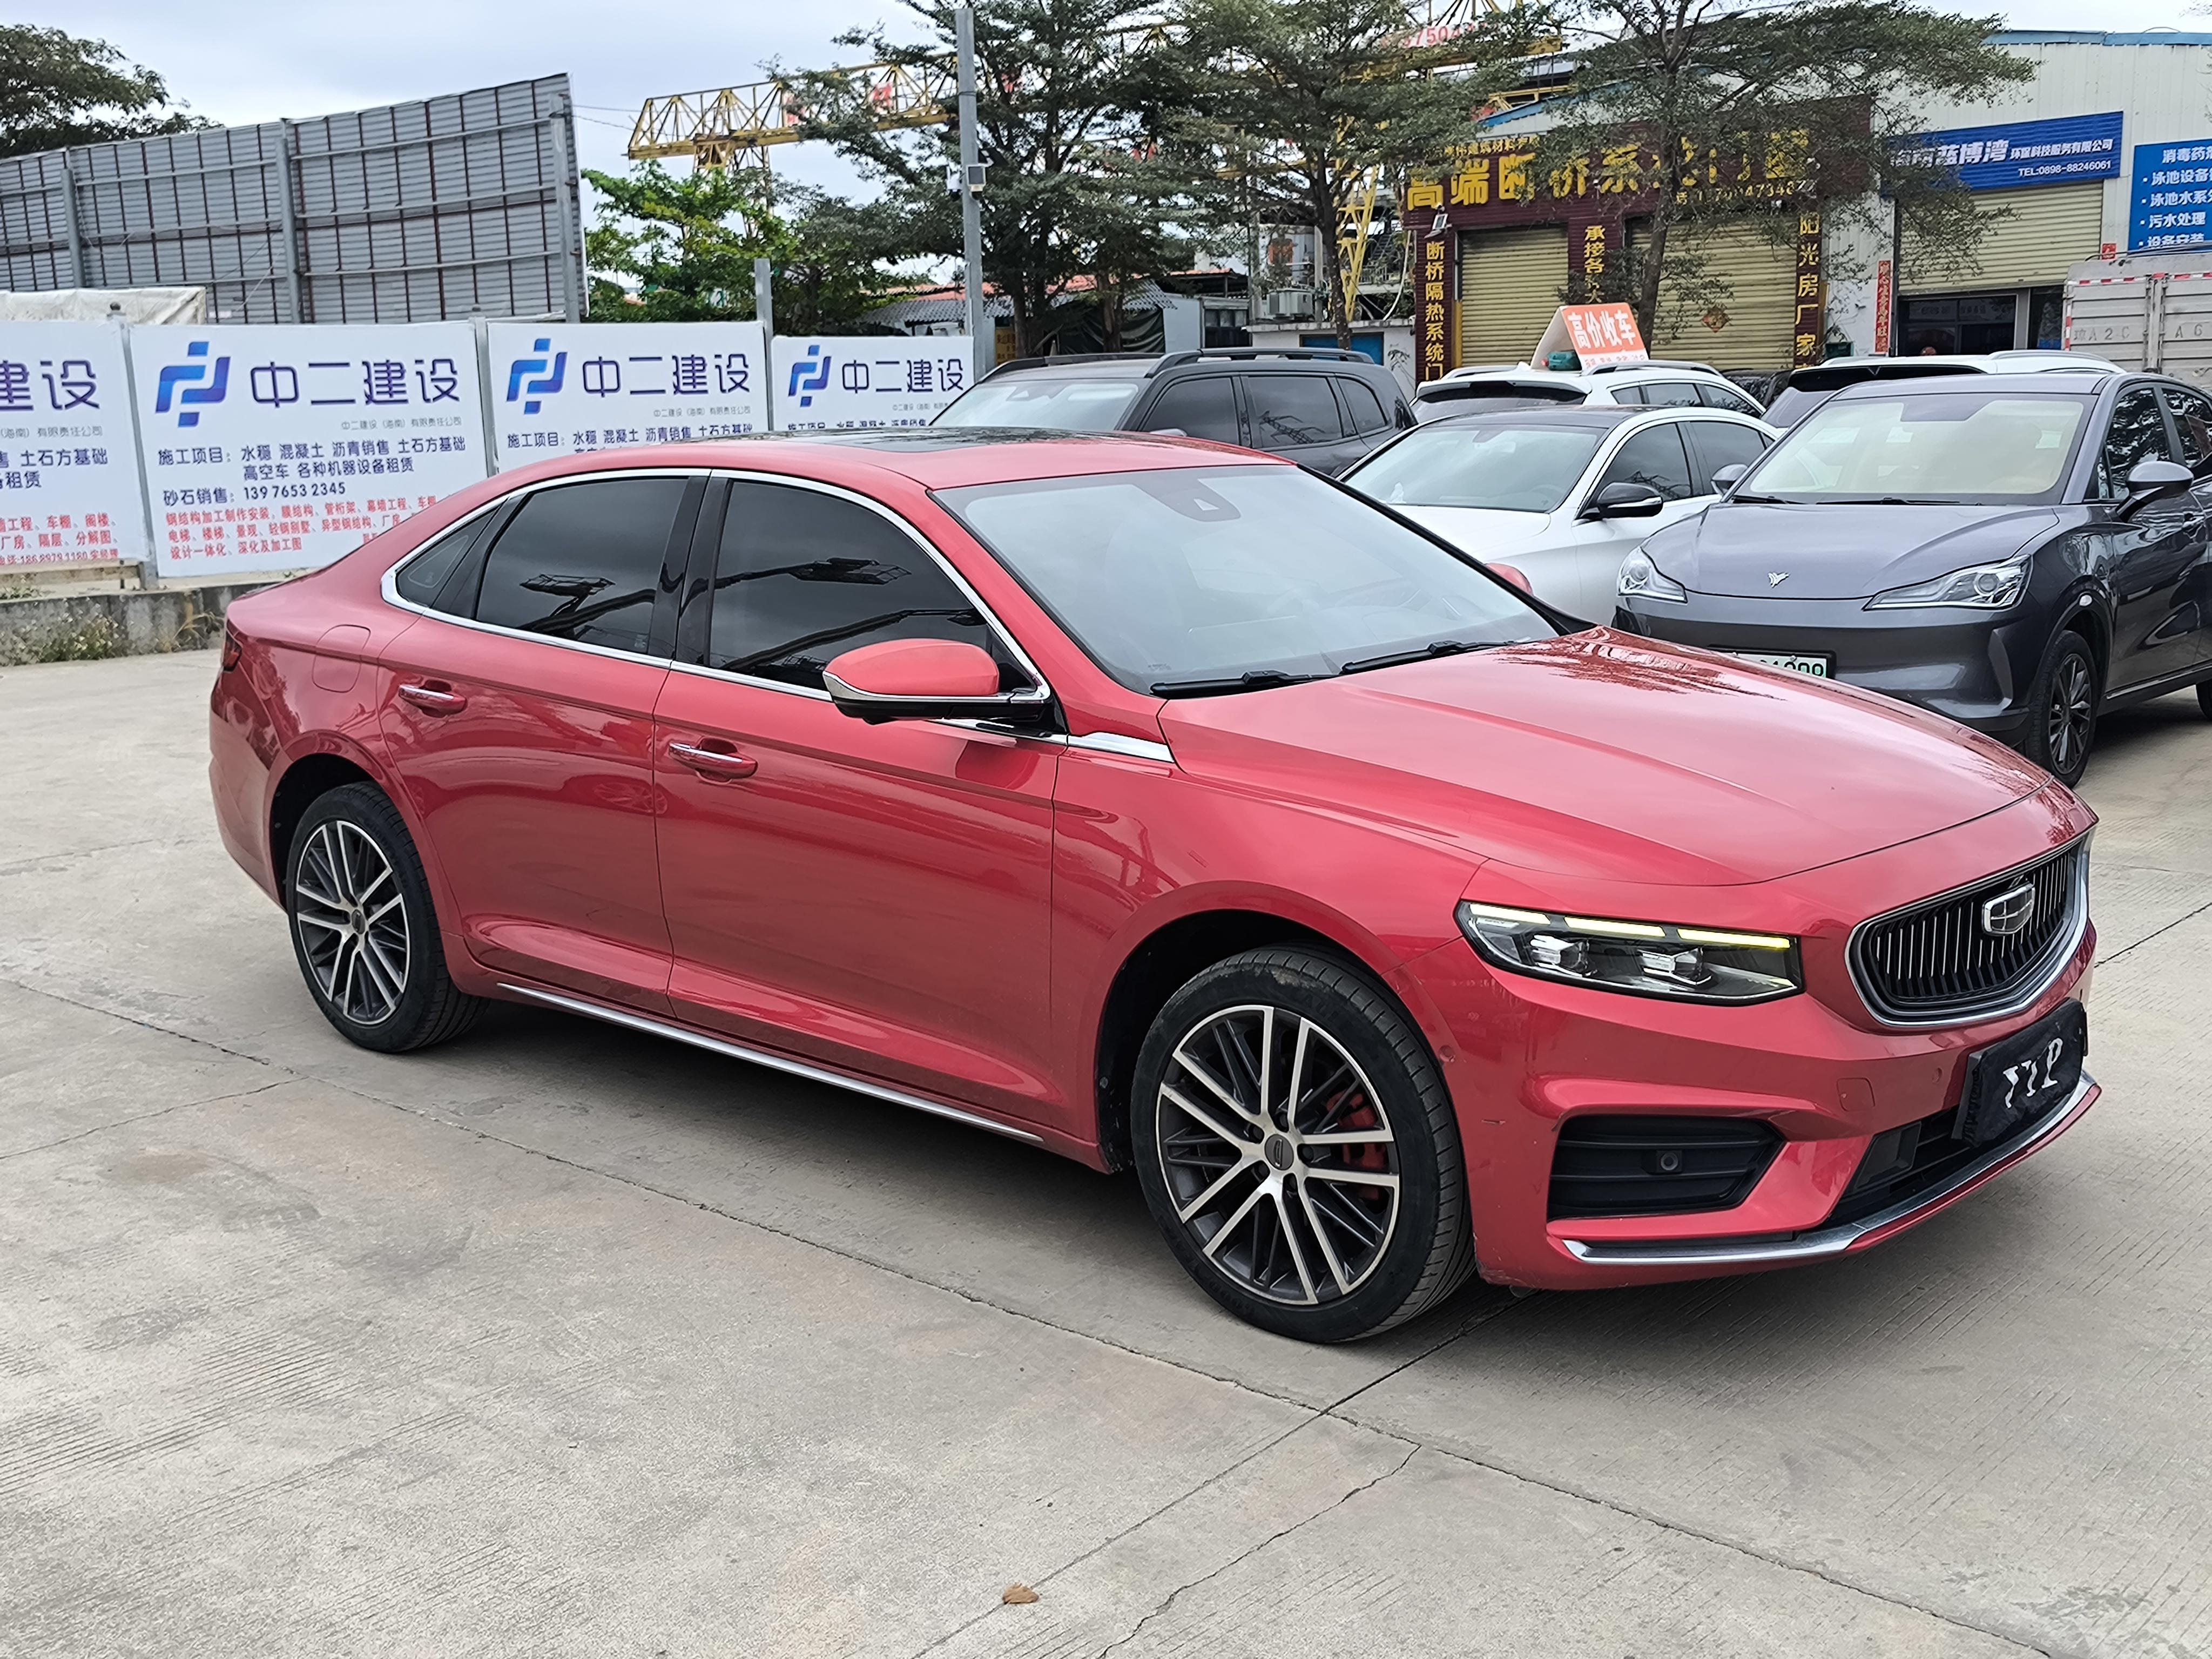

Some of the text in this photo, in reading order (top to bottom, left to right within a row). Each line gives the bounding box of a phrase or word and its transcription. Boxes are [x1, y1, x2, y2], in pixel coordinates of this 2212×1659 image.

[2018, 160, 2111, 178] TEL:0898-88246061
[2151, 167, 2212, 186] 泳池设备
[2148, 211, 2207, 228] 污水处理
[1567, 309, 1636, 350] 高价收车
[250, 358, 461, 408] 中二建设
[582, 353, 750, 397] 中二建设
[841, 359, 964, 394] 中二建设
[603, 428, 639, 443] 混凝土
[21, 447, 108, 467] 土石方基础
[279, 442, 324, 460] 混凝土
[332, 438, 390, 458] 沥青销售
[398, 435, 466, 454] 土石方基础
[243, 456, 415, 481] 高空车 各种机器设备租赁
[0, 470, 42, 489] 租赁
[244, 487, 268, 500] 139
[272, 484, 308, 498] 7653
[311, 482, 346, 496] 2345
